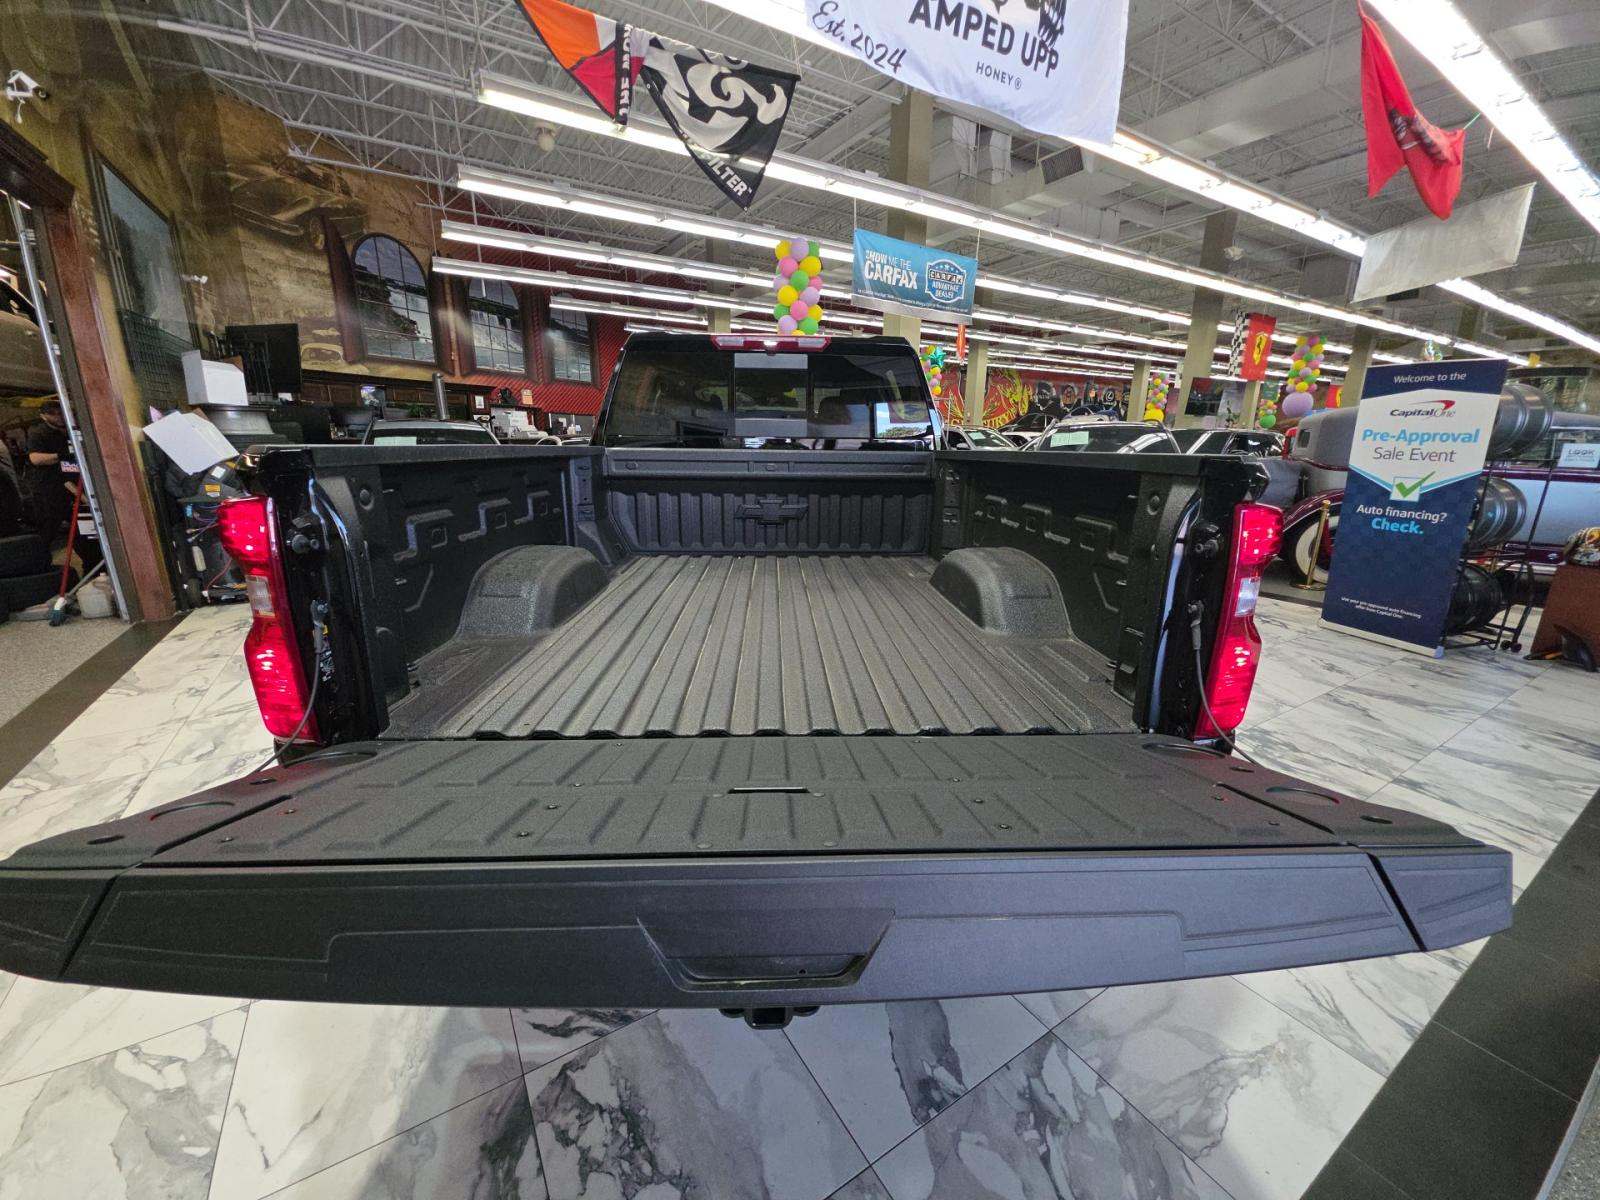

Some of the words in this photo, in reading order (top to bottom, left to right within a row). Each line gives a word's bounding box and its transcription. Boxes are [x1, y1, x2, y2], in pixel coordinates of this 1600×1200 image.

[908, 0, 1015, 56] AMPED
[811, 1, 846, 43] Est.
[850, 24, 908, 75] 2024
[900, 259, 912, 271] THE
[864, 260, 918, 290] CARFAX
[1393, 375, 1435, 384] Welcome
[1438, 373, 1448, 381] to
[1450, 372, 1467, 381] the
[1361, 428, 1481, 446] Pre-Approval
[1373, 446, 1405, 461] Sale
[1409, 447, 1457, 463] Event
[1356, 504, 1383, 515] Auto
[1385, 506, 1448, 524] financing?
[1371, 517, 1424, 535] Check.
